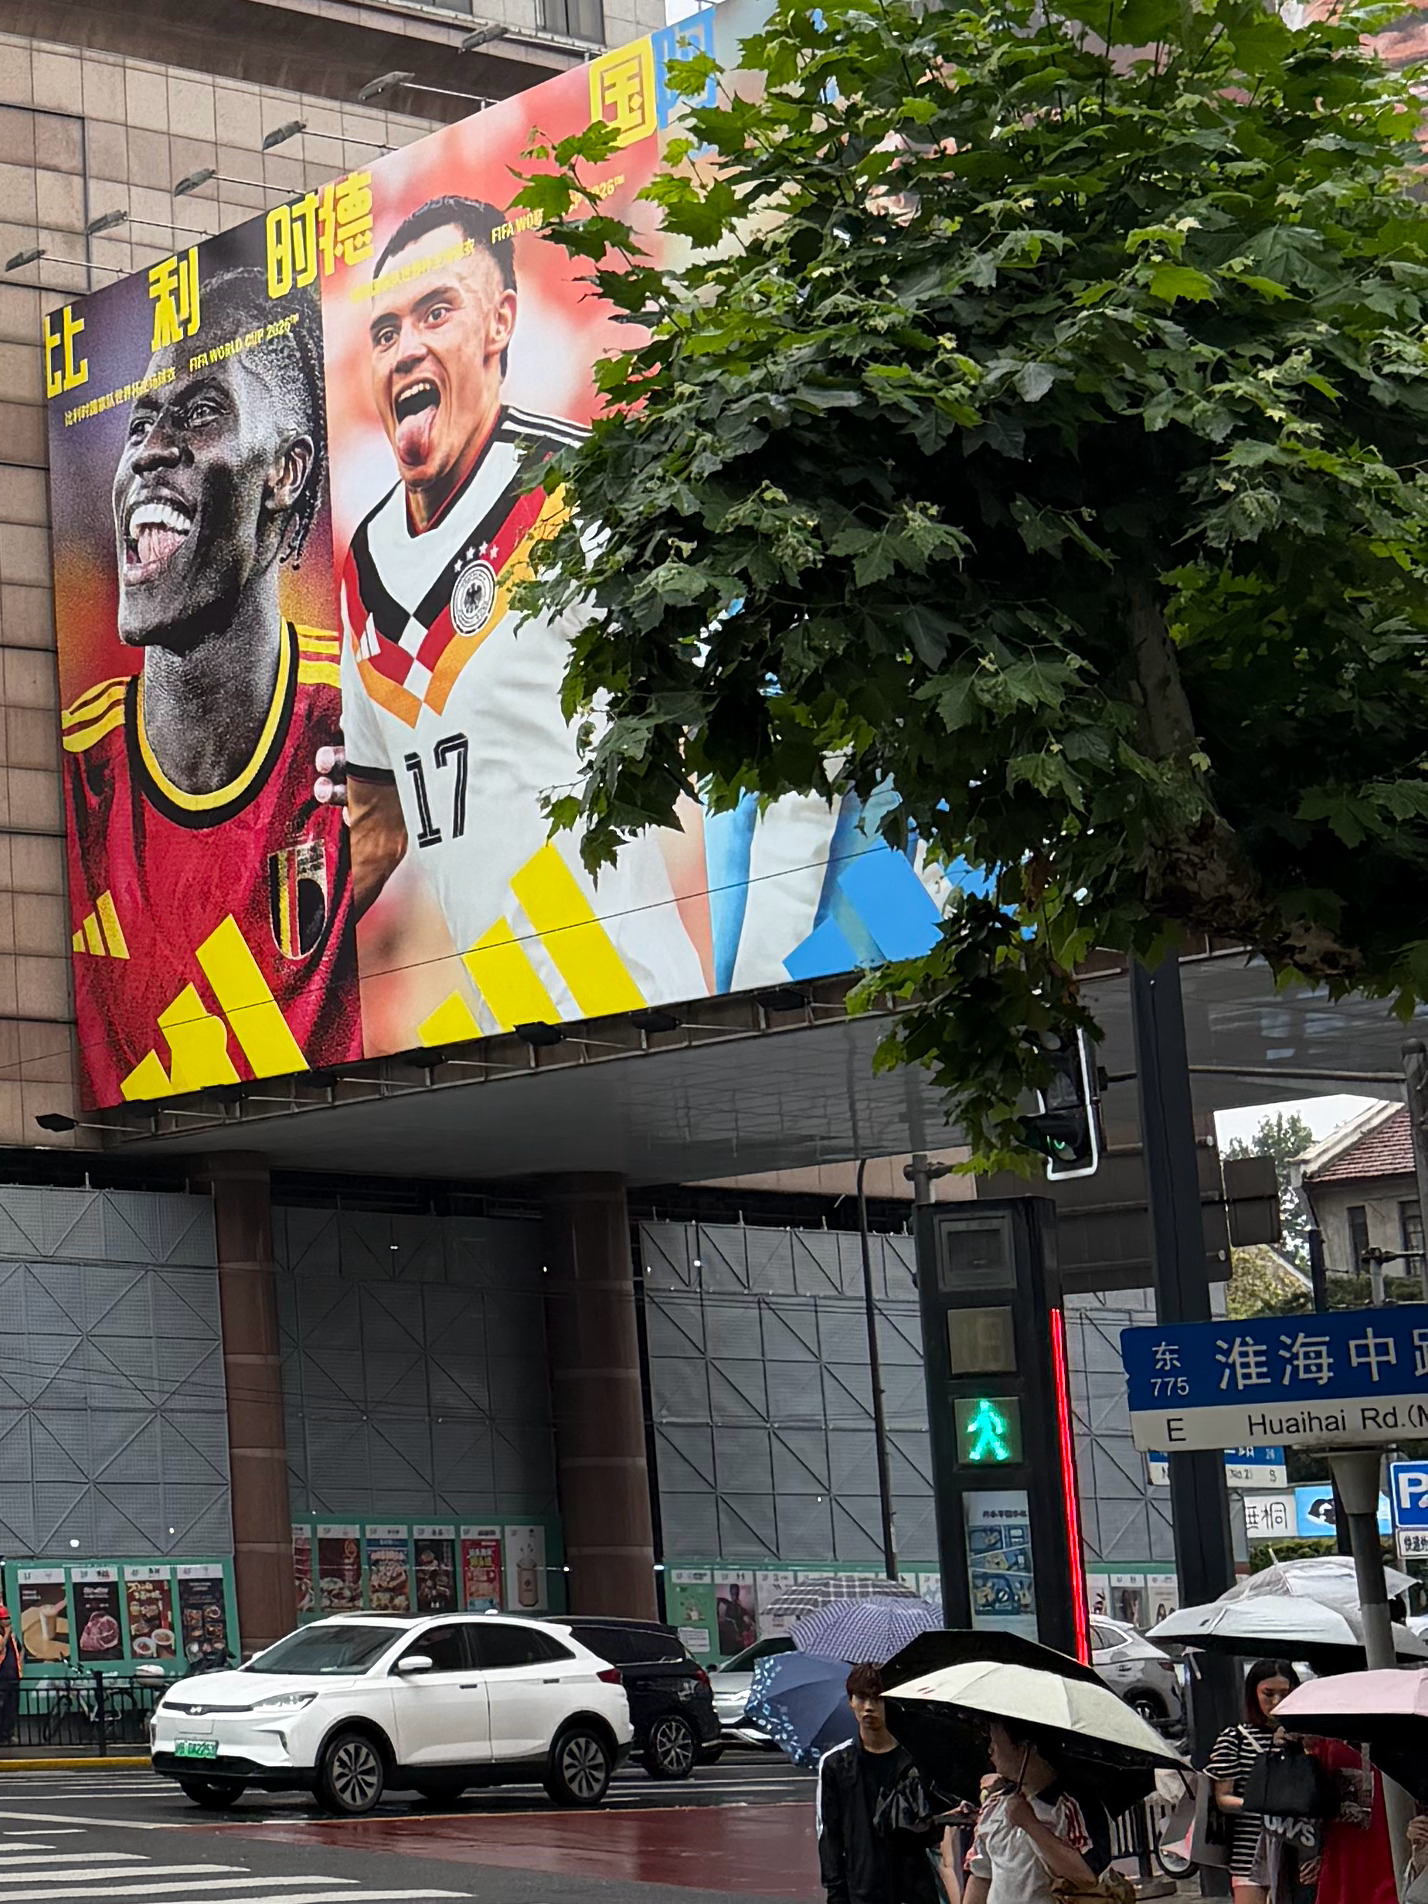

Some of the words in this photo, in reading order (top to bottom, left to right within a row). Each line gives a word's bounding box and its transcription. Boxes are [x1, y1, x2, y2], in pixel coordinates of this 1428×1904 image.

[189, 355, 209, 373] FIFA
[209, 336, 243, 364] WORLD
[404, 731, 470, 849] 17
[1151, 1341, 1181, 1371] 东
[1150, 1376, 1189, 1397] 775
[1166, 1417, 1187, 1442] E
[1248, 1408, 1347, 1437] Huaihai
[1398, 1472, 1428, 1509] P
